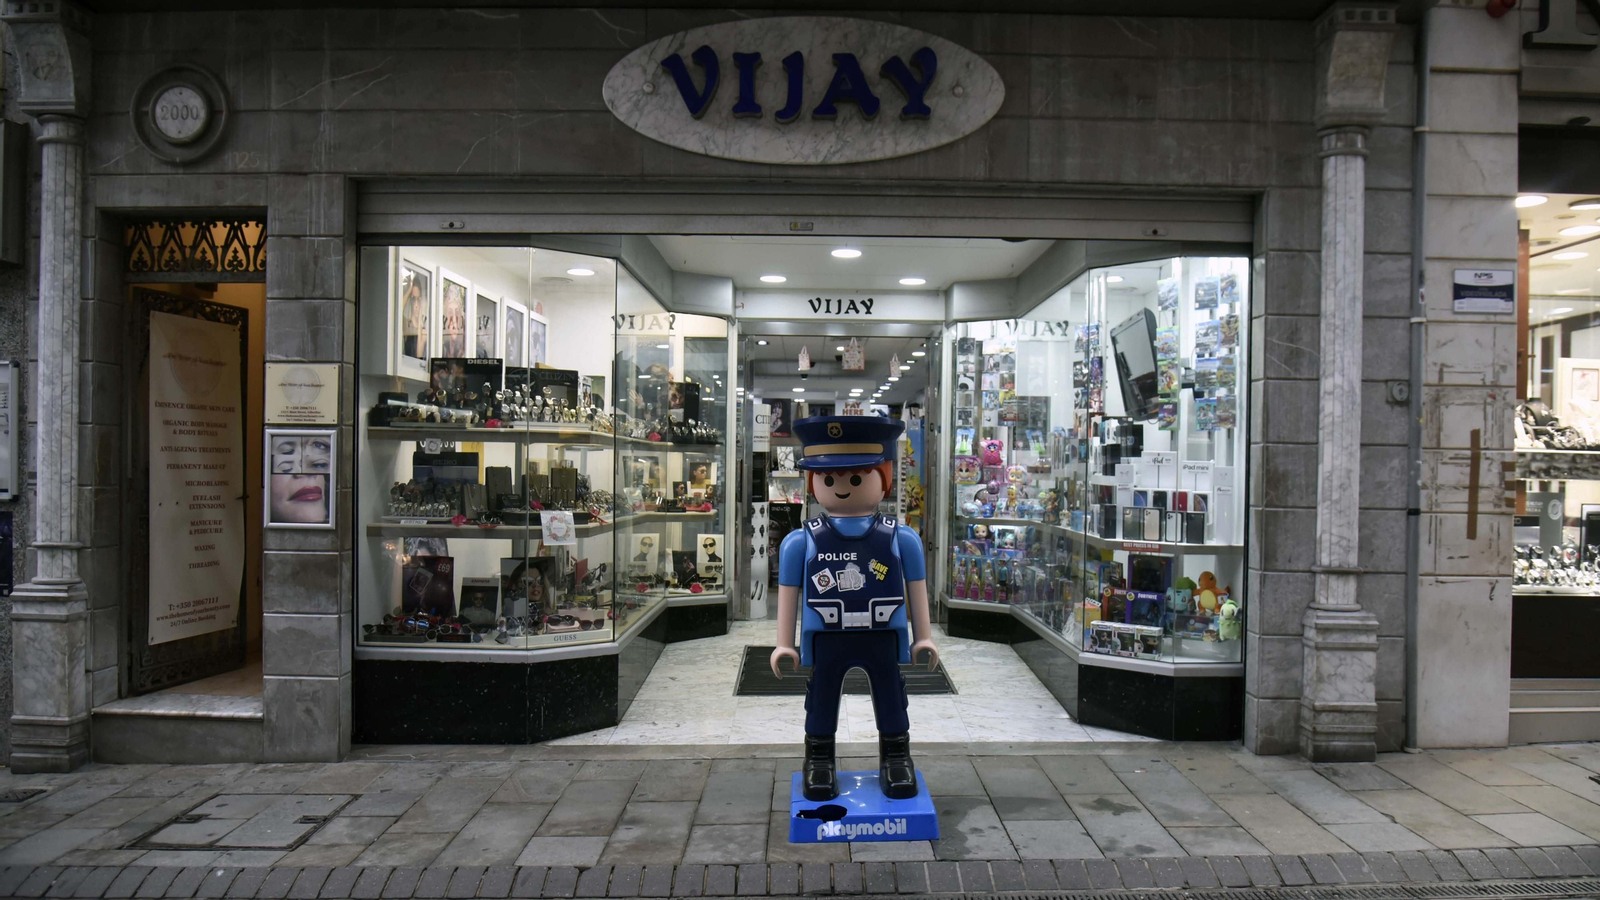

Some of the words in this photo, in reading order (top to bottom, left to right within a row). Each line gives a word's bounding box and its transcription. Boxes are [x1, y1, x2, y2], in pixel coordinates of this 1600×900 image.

[660, 44, 938, 125] VIJAY
[160, 104, 199, 121] 2000
[808, 297, 874, 315] VIJAY
[611, 314, 676, 331] VIJAY
[1005, 320, 1070, 337] VIJAY
[842, 408, 864, 416] HERE
[190, 420, 205, 428] BODY
[205, 421, 227, 429] MASSAGE
[198, 446, 231, 454] TREATMENTS
[194, 544, 216, 552] WAXING
[818, 552, 858, 562] POLICE
[189, 560, 220, 570] THREADING
[437, 562, 451, 573] £69
[176, 601, 191, 609] +350
[192, 597, 219, 607] 20067111
[170, 620, 181, 628] 24/7
[198, 614, 216, 622] Booking
[554, 634, 577, 642] GUESS
[817, 818, 907, 841] playmobil
